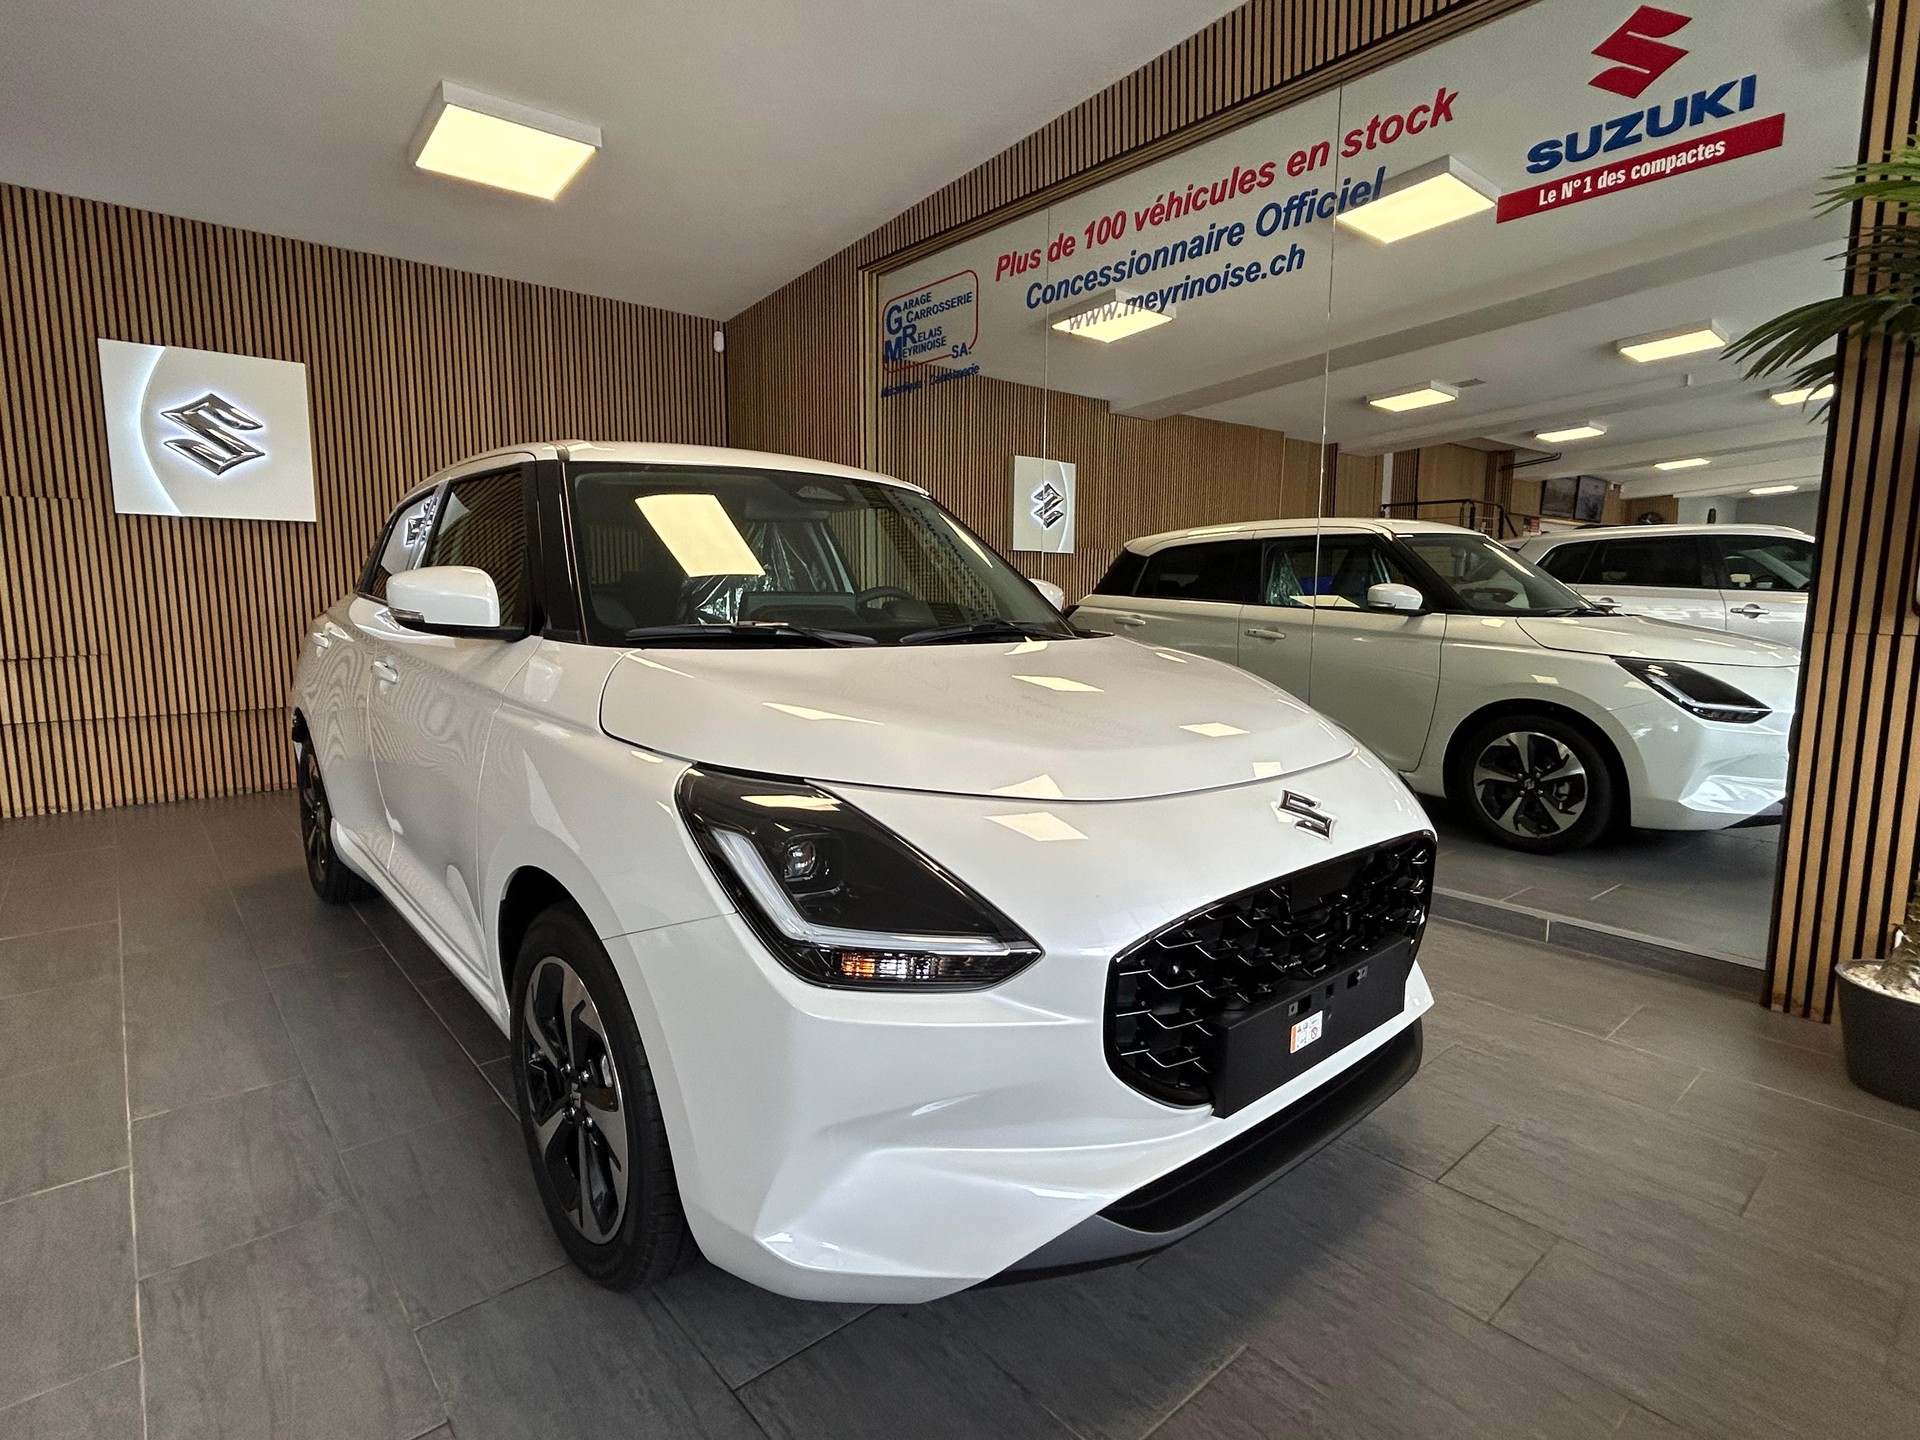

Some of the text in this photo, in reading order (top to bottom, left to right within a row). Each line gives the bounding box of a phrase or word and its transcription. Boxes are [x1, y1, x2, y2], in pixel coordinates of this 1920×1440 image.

[1526, 74, 1757, 174] SUZUKI
[995, 87, 1459, 281] Plus de 100 véhicules en stock
[1538, 188, 1556, 206] Le
[1597, 170, 1626, 188] des
[1631, 140, 1726, 178] compactes
[1026, 166, 1386, 309] Concessionnaire Officiel
[906, 292, 973, 323] CARROSSERIE
[1069, 244, 1305, 331] www.meyrinoise.ch
